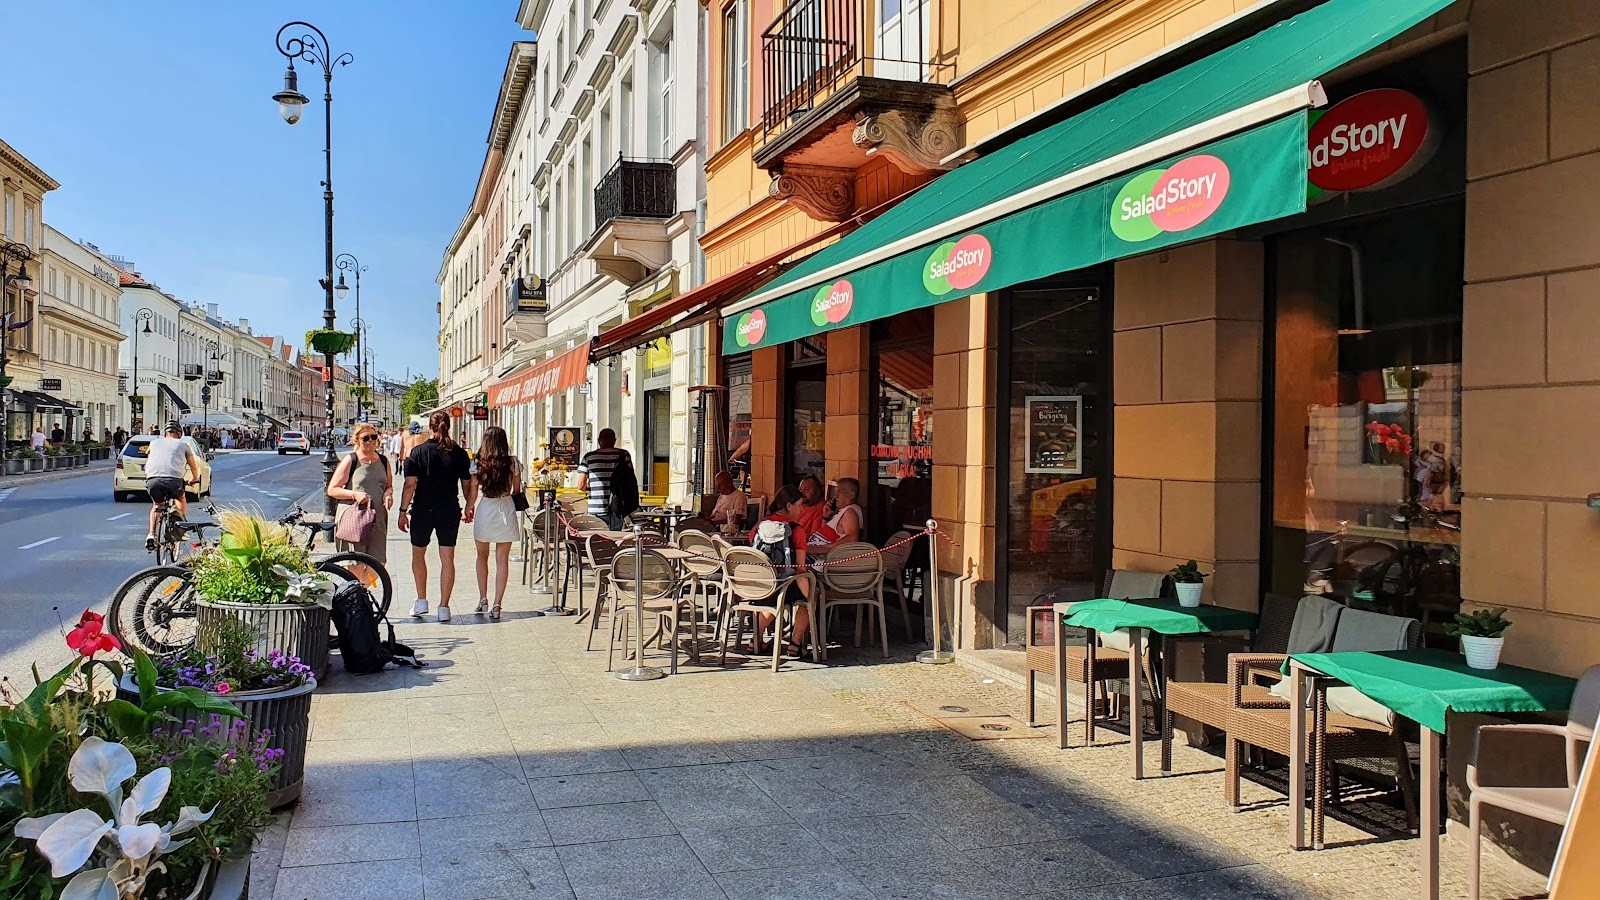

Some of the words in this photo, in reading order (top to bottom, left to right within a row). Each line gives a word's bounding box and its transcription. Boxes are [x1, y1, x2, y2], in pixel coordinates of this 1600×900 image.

[1307, 113, 1408, 170] dStory
[1120, 172, 1217, 221] SaladStory
[929, 247, 985, 280] SaladStory
[815, 290, 850, 313] SaladStory
[738, 318, 764, 336] SaladStory
[1038, 411, 1068, 423] Burgery
